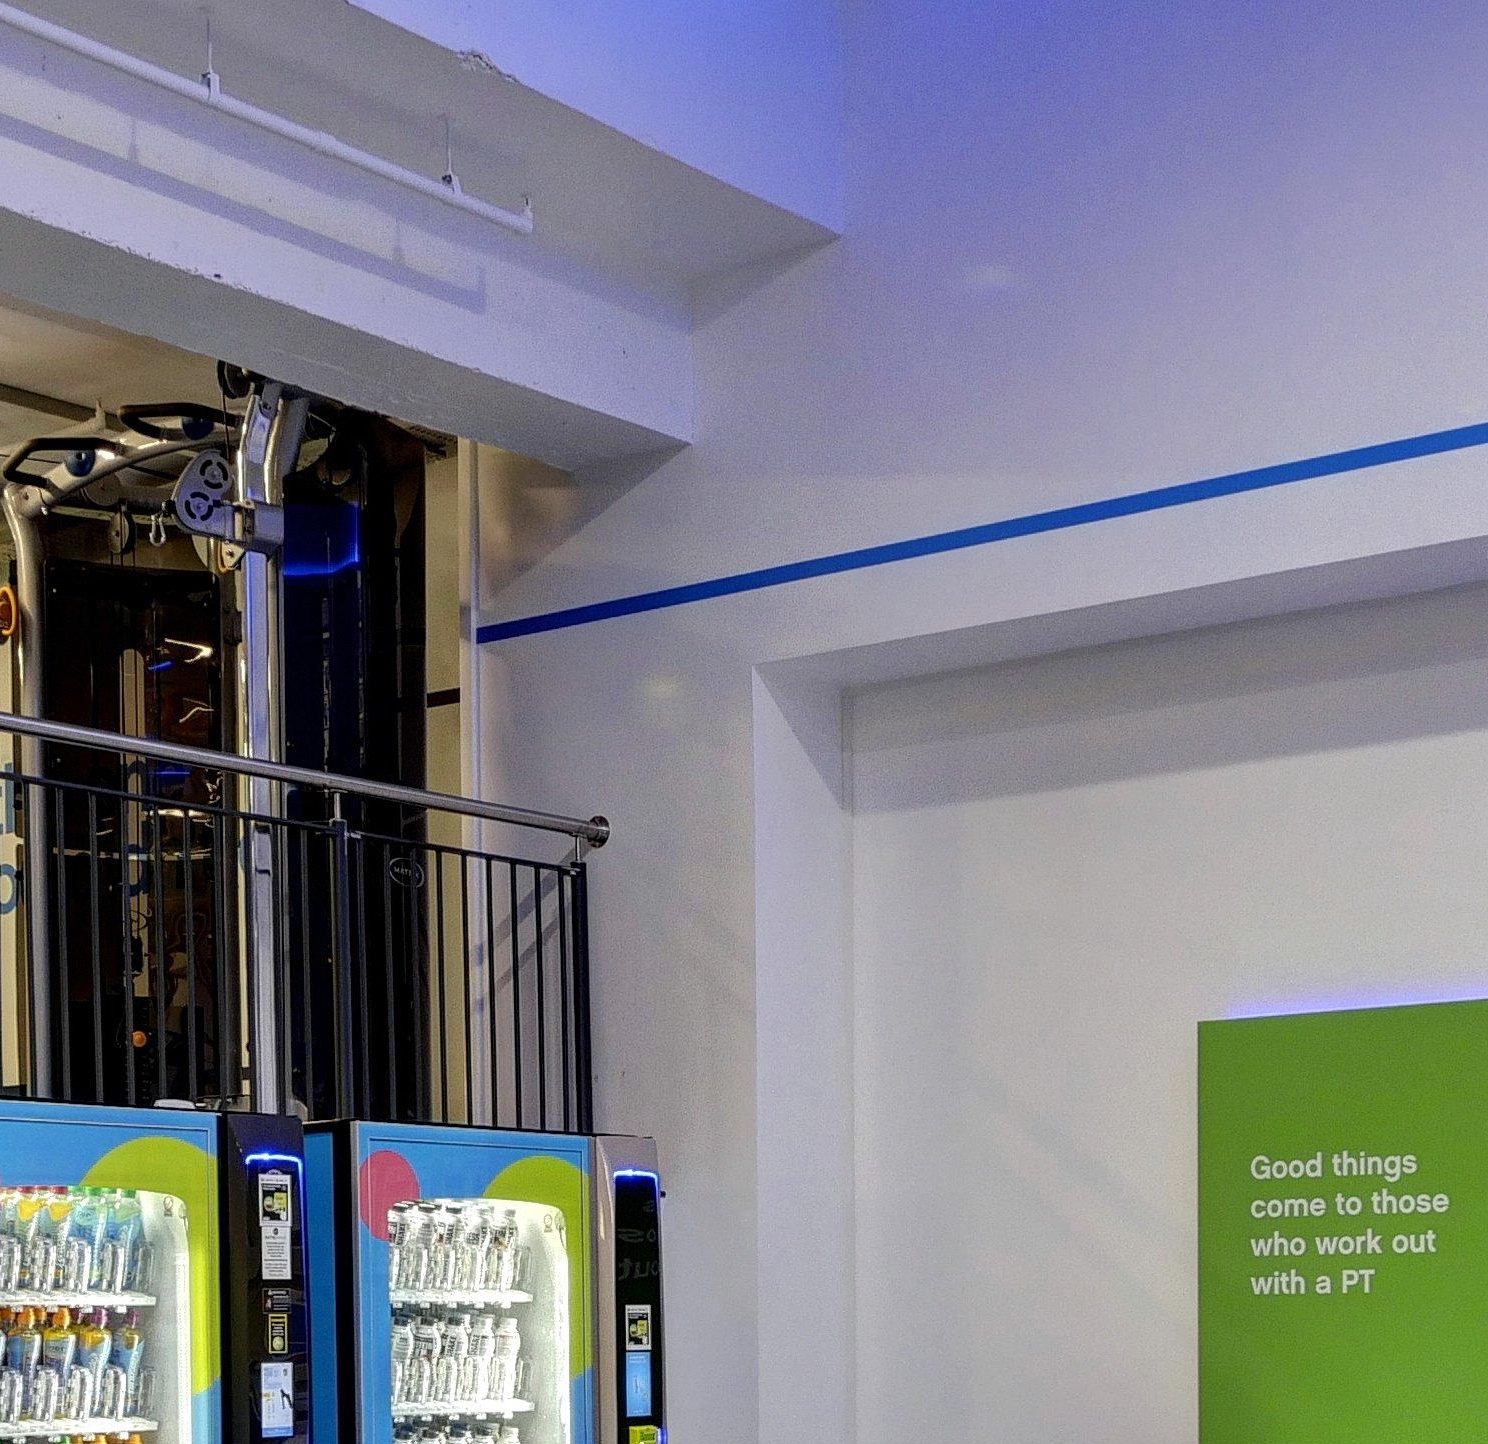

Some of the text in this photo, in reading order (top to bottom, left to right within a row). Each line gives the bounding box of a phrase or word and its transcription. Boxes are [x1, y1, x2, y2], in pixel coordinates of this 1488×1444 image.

[1251, 1150, 1418, 1182] Good things
[1251, 1188, 1450, 1218] come to those
[1251, 1228, 1436, 1256] who work out
[1251, 1269, 1376, 1295] with a PT
